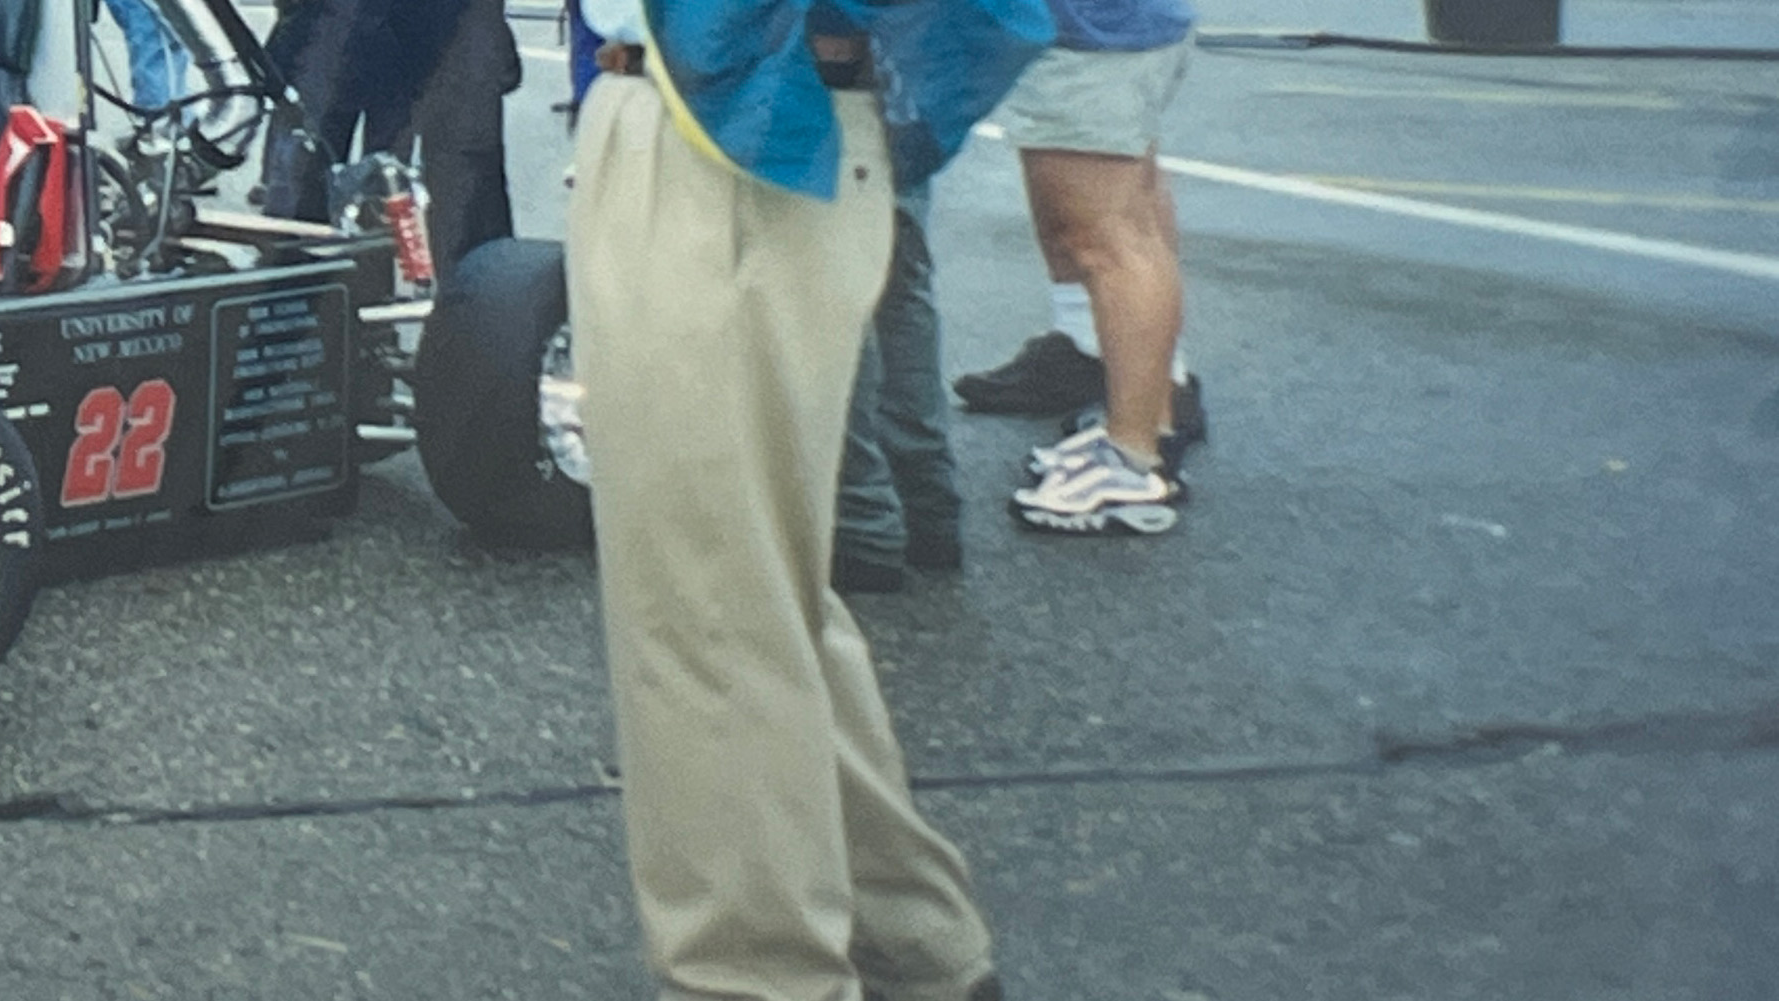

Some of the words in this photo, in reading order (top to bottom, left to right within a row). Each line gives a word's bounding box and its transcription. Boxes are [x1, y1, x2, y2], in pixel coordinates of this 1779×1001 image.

[60, 307, 166, 340] UNIVERSITY
[172, 303, 195, 325] OF
[73, 341, 112, 365] NEW
[117, 332, 183, 358] MEXICO
[60, 378, 178, 509] 22
